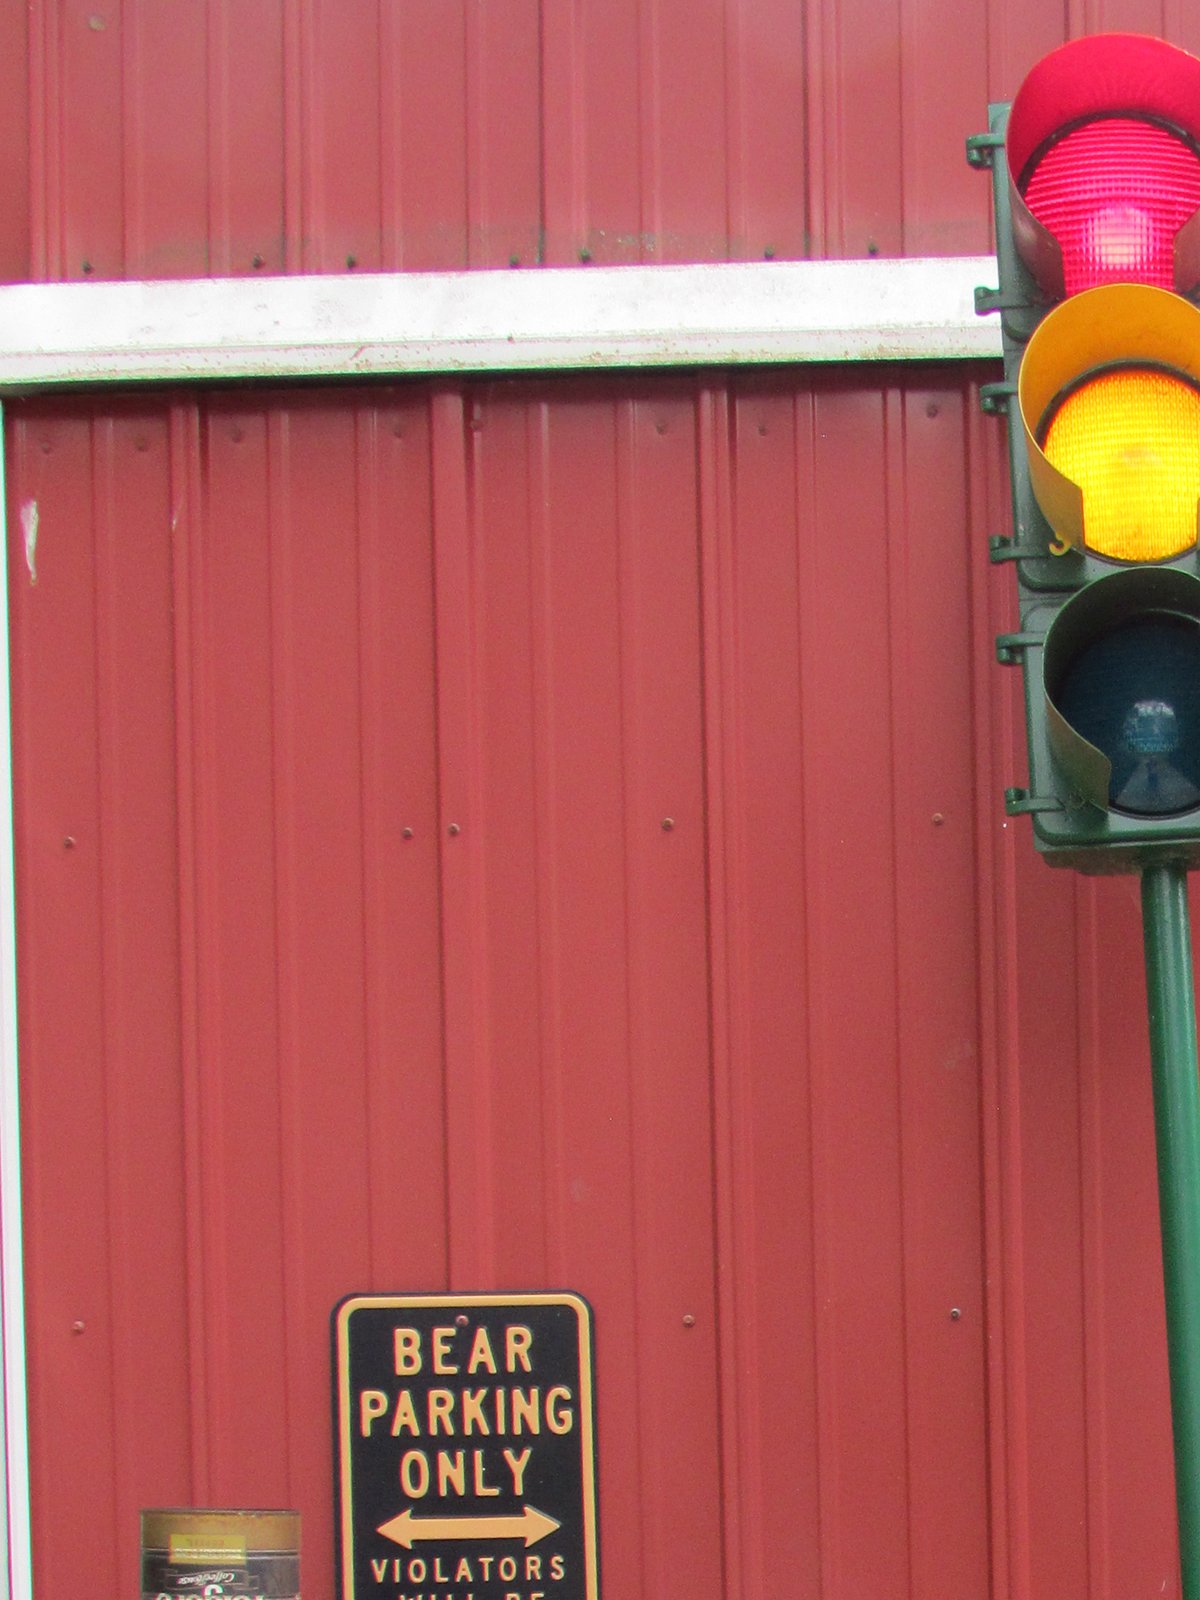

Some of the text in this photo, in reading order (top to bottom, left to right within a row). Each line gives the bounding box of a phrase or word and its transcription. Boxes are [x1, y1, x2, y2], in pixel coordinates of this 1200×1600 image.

[393, 1327, 533, 1376] BEAR
[360, 1387, 573, 1437] PARKING
[400, 1448, 532, 1498] ONLY
[371, 1555, 566, 1583] VIOLATORS
